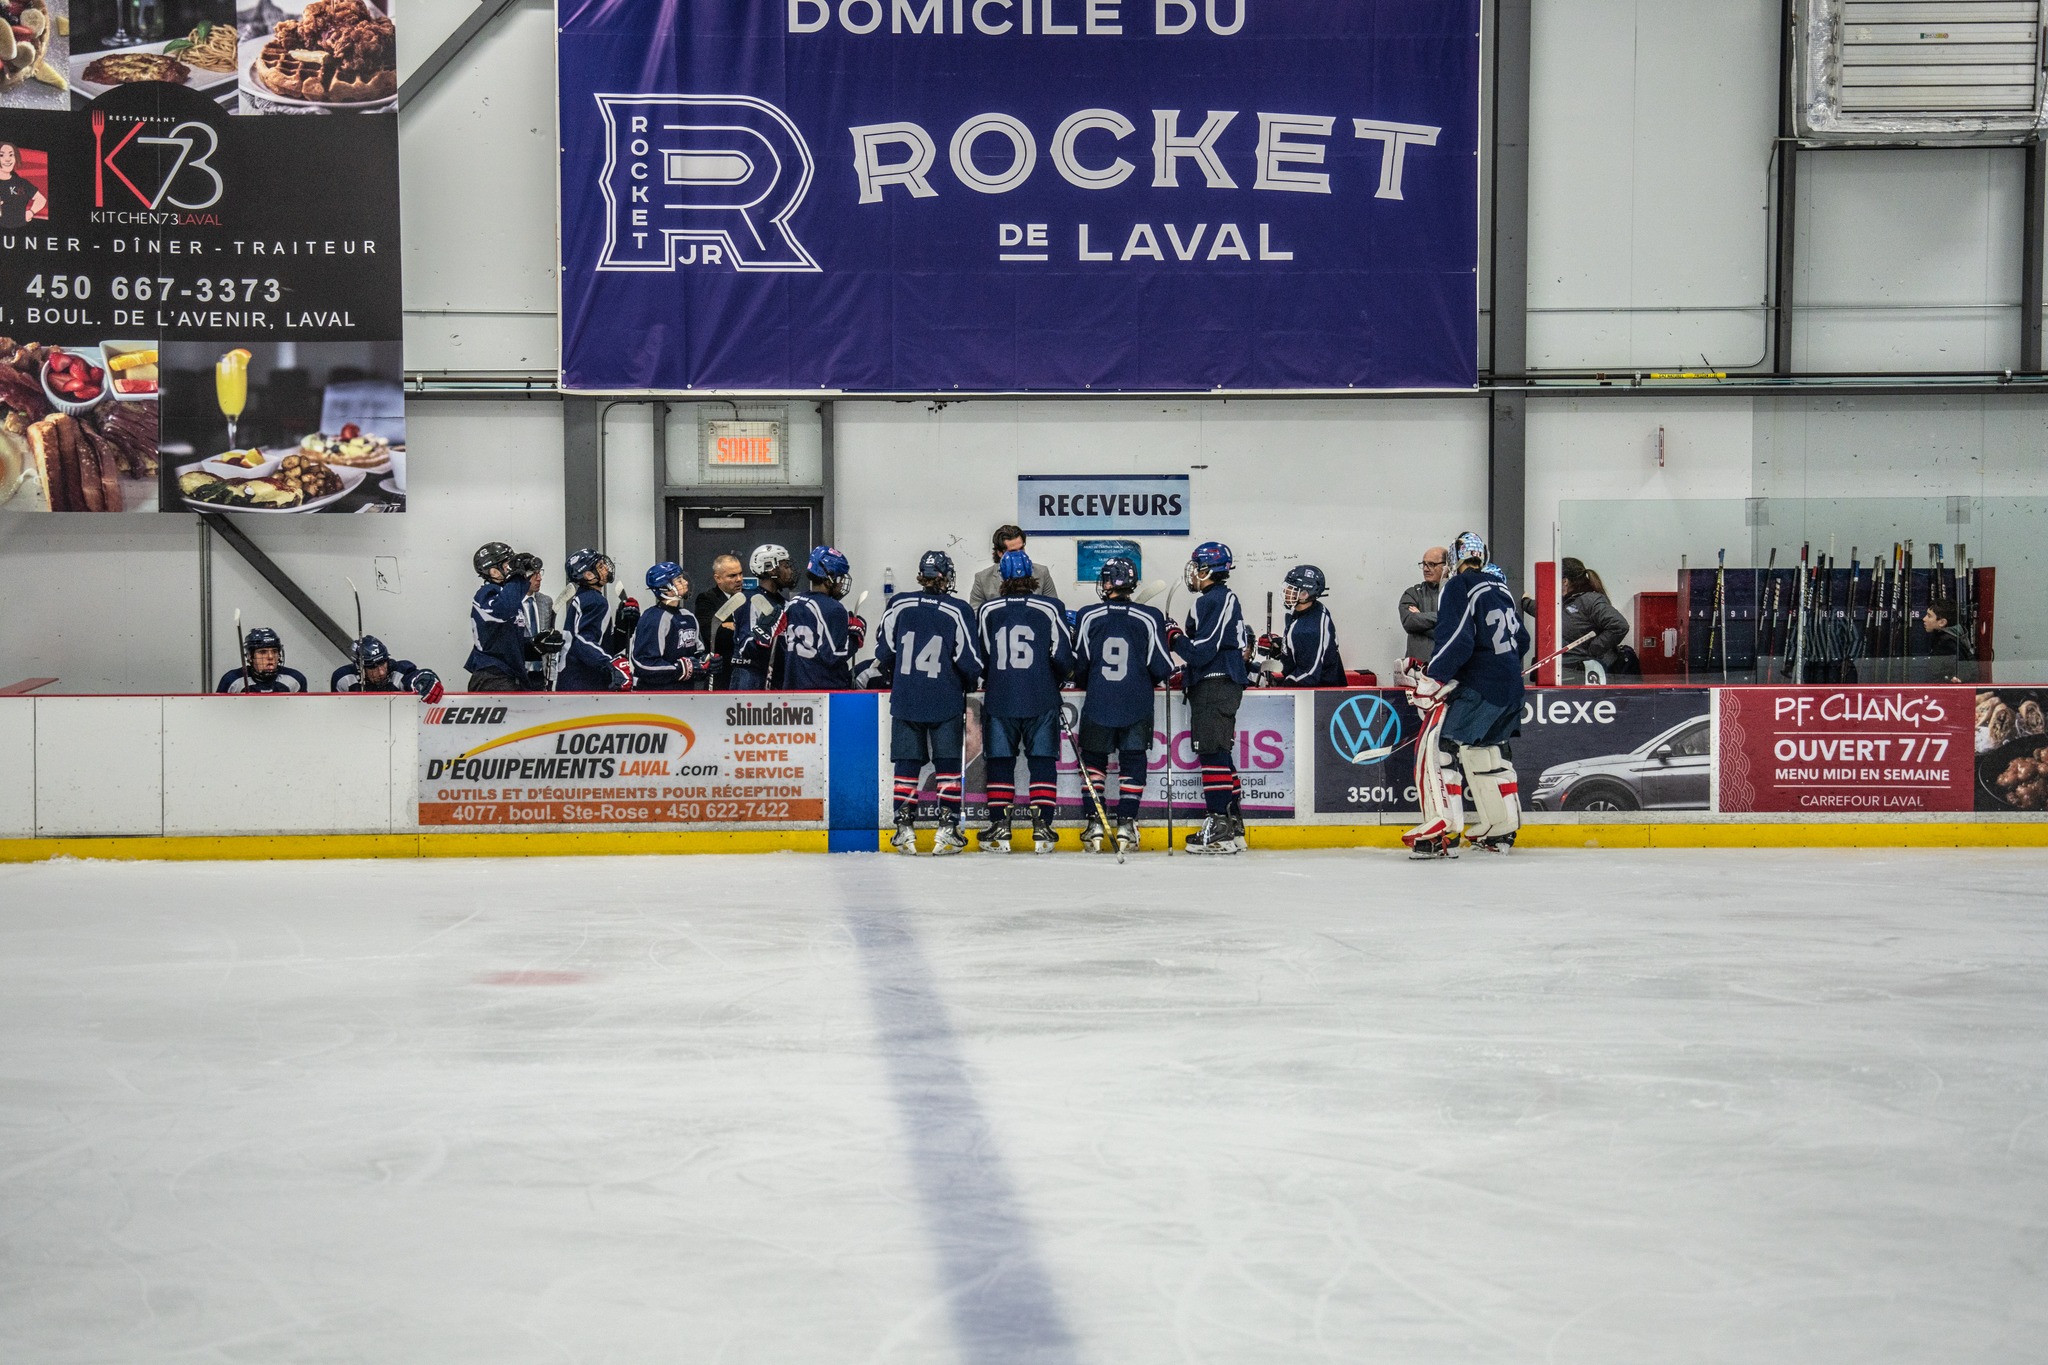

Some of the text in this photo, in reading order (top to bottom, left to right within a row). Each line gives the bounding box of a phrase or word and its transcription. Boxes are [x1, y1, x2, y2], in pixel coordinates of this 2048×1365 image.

[788, 0, 1246, 36] DOMICILE DU
[108, 114, 176, 124] RESTAURANT
[849, 108, 1441, 204] ROCKET
[631, 116, 649, 249] ROCKET
[3, 235, 80, 251] UNER
[113, 237, 202, 255] DÎNER
[234, 240, 377, 255] TRAITEUR
[999, 223, 1294, 261] DE LAVAL
[678, 244, 722, 265] JR
[26, 274, 281, 302] 450 667-3373
[27, 308, 101, 325] BOUL.
[114, 310, 145, 325] DE
[286, 312, 356, 327] LAVAL
[717, 437, 772, 463] SORTIE
[1039, 493, 1182, 516] RECEVEURS
[900, 630, 943, 679] 14
[995, 624, 1035, 670] 16
[1101, 636, 1129, 682] 9
[441, 707, 508, 724] ECHO
[725, 702, 814, 726] shindaiwa
[1774, 696, 1815, 727] P.F.
[555, 733, 668, 755] LOCATION
[734, 732, 817, 745] LOCATION
[734, 750, 789, 762] VENTE
[1146, 730, 1285, 771] COIS
[1774, 737, 1949, 763] OUVERT 7/7
[618, 760, 671, 777] LAVAL
[675, 764, 719, 776] .com
[734, 767, 805, 779] SERVICE
[1775, 768, 1950, 781] MENU MIDI EN SEMAINE
[437, 788, 498, 800] OUTILS
[502, 788, 523, 800] ET
[662, 787, 707, 799] POUR
[711, 784, 802, 798] RÉCEPTION
[1160, 790, 1198, 800] Dstrict
[1347, 786, 1398, 805] 3501,
[1800, 795, 1924, 807] CARREFOUR LAVAL
[452, 802, 790, 823] 4077, boul. Ste-Rose 450 622-7422
